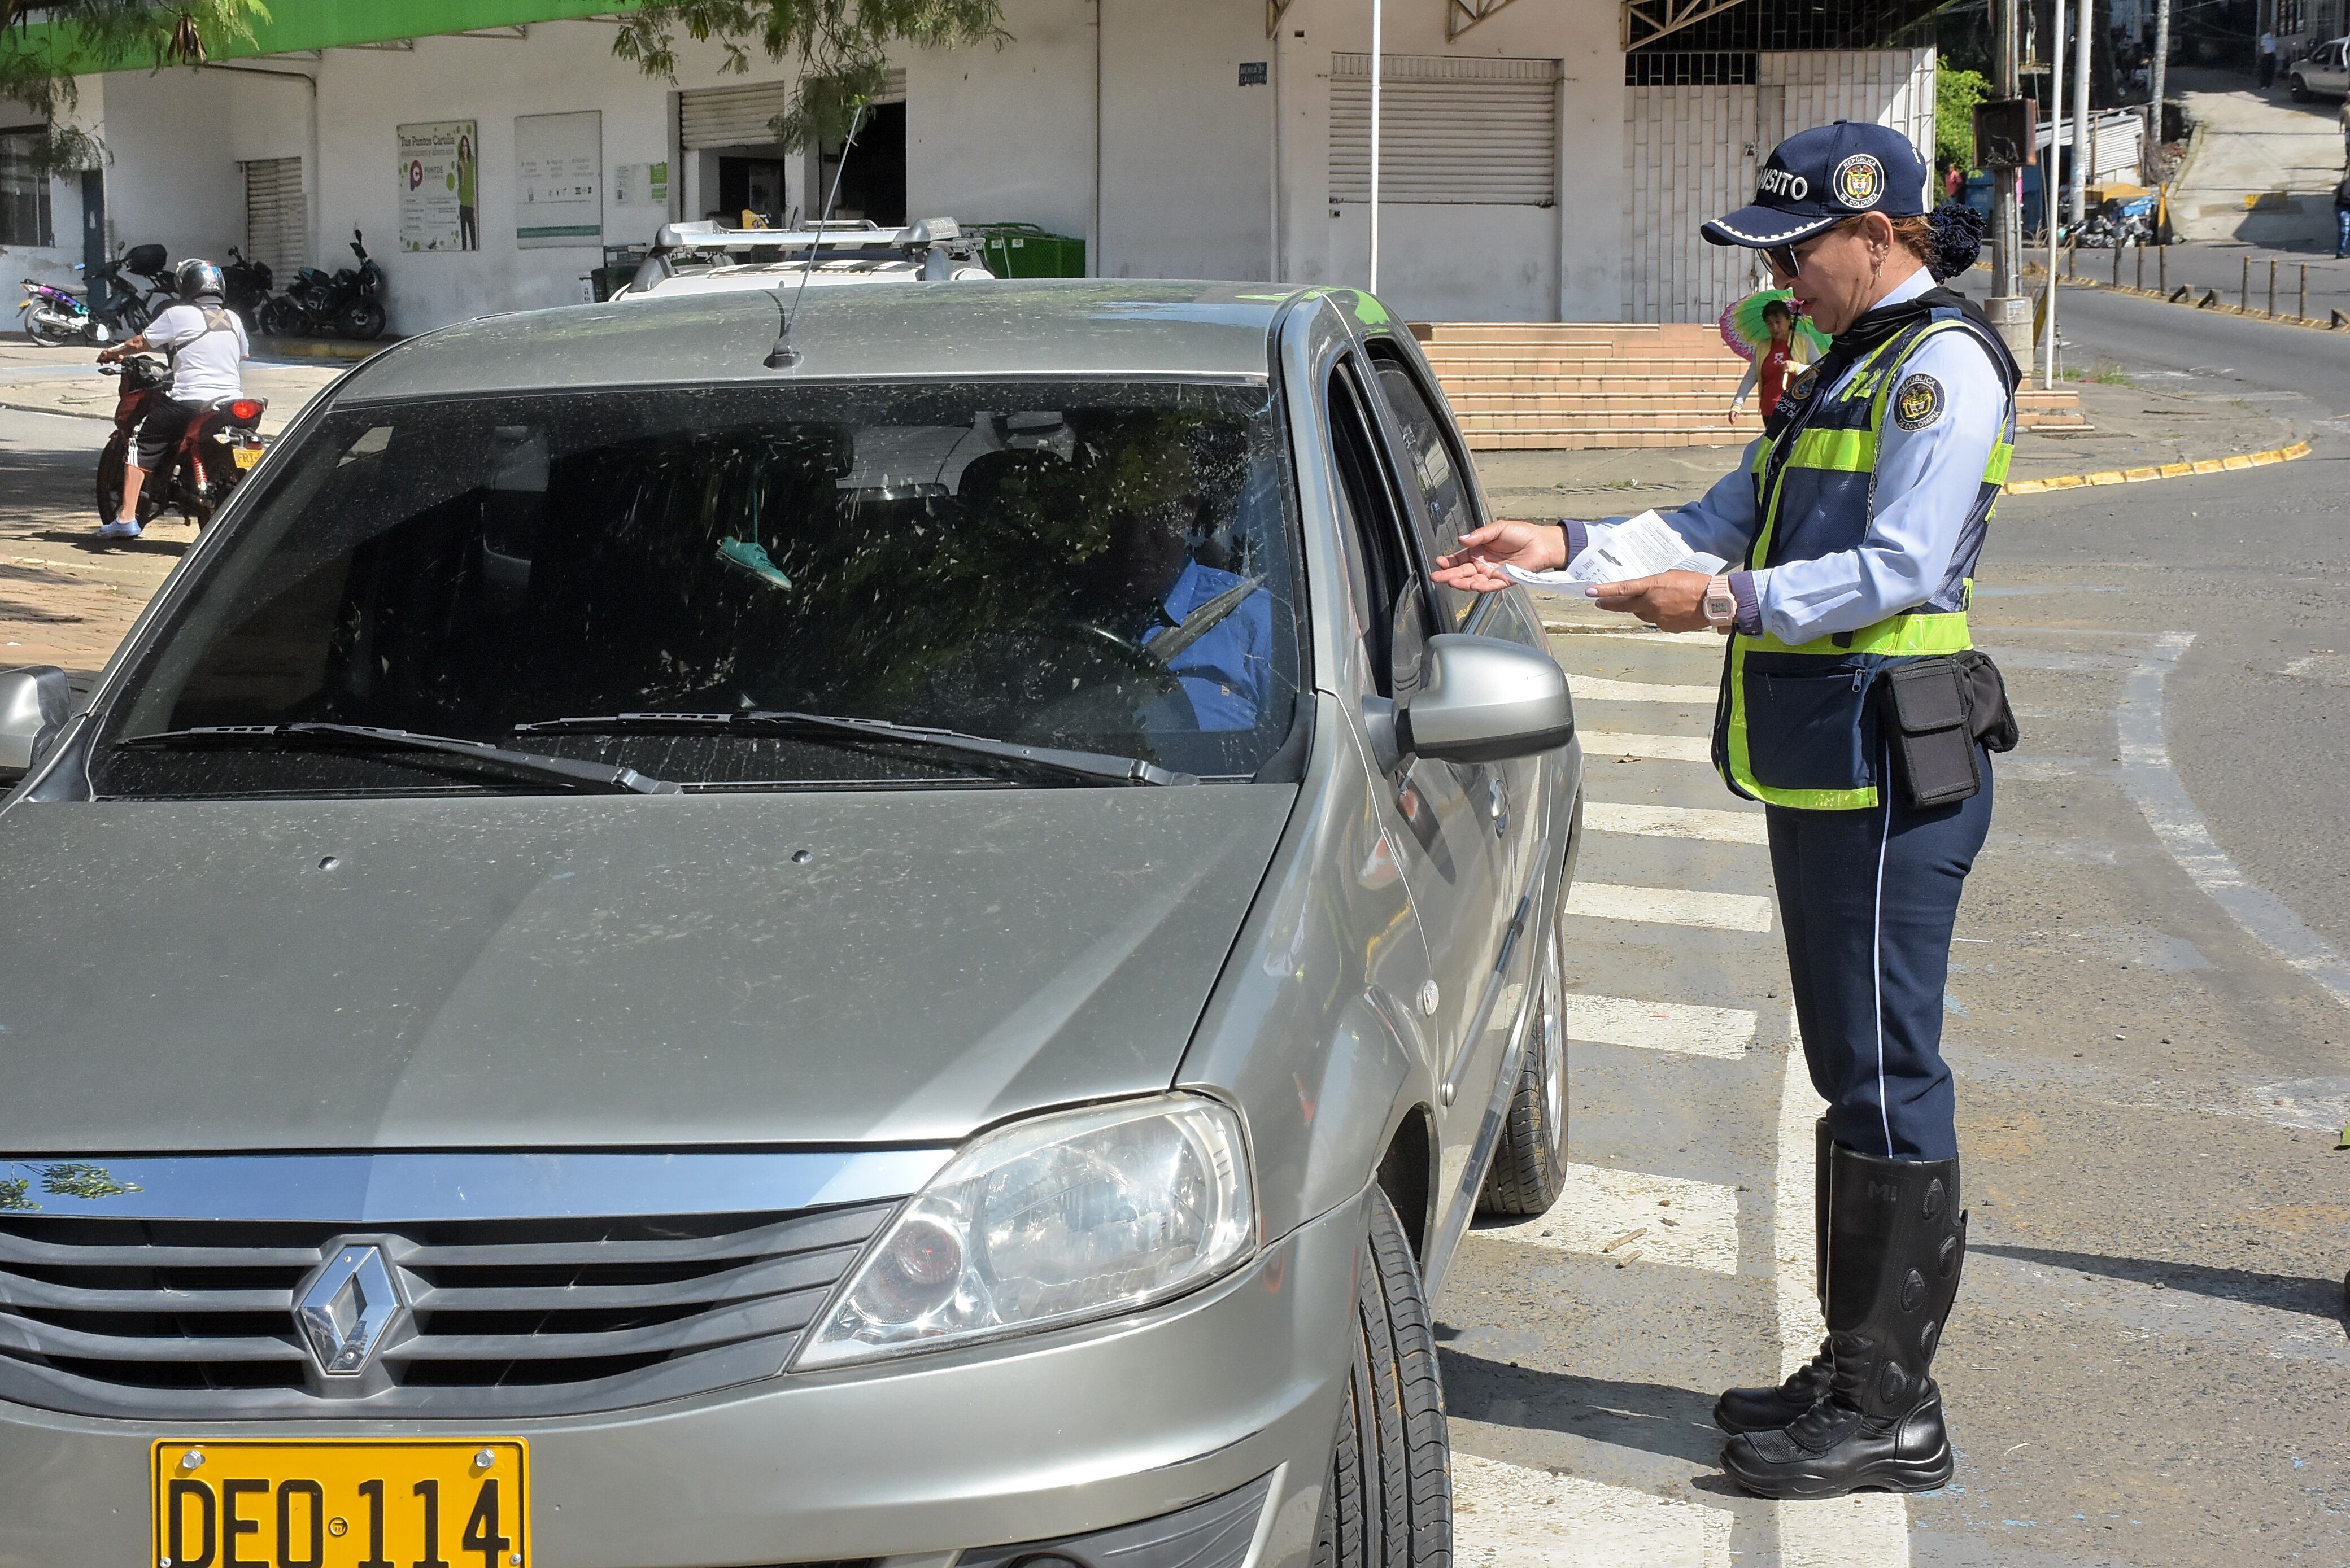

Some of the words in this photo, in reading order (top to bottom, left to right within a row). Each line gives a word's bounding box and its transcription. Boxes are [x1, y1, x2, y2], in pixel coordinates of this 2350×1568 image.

[412, 136, 432, 146] Puntos
[1758, 168, 1808, 201] NSITO
[1839, 192, 1848, 202] DE
[1848, 192, 1879, 207] COLOMBIA
[1898, 418, 1906, 428] DE
[1904, 410, 1941, 430] COLOMBIA
[168, 1478, 325, 1568] DEO
[357, 1478, 511, 1568] 114
